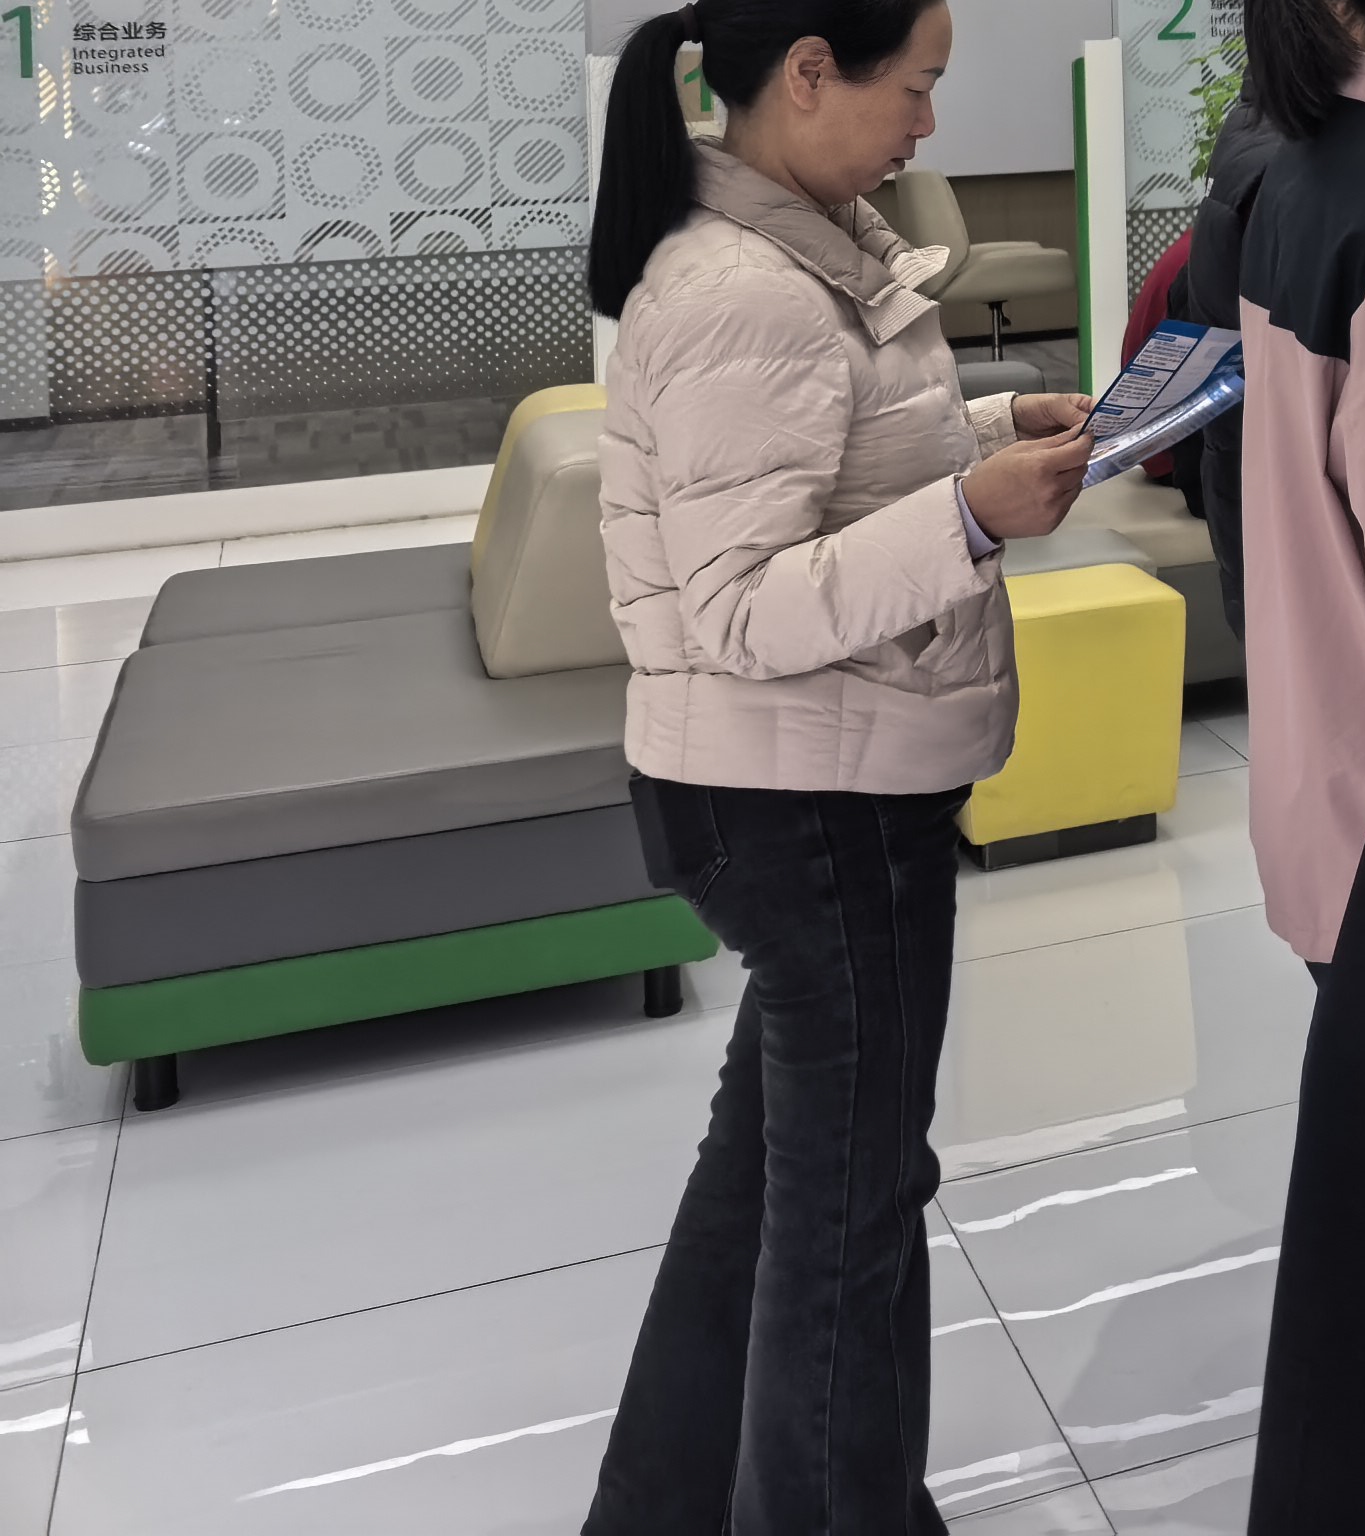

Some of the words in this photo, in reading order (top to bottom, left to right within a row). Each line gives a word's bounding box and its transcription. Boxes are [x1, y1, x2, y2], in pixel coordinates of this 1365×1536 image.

[73, 22, 167, 41] 综合业务
[2, 6, 33, 78] 1
[73, 45, 165, 62] Integrated
[73, 62, 149, 75] Business
